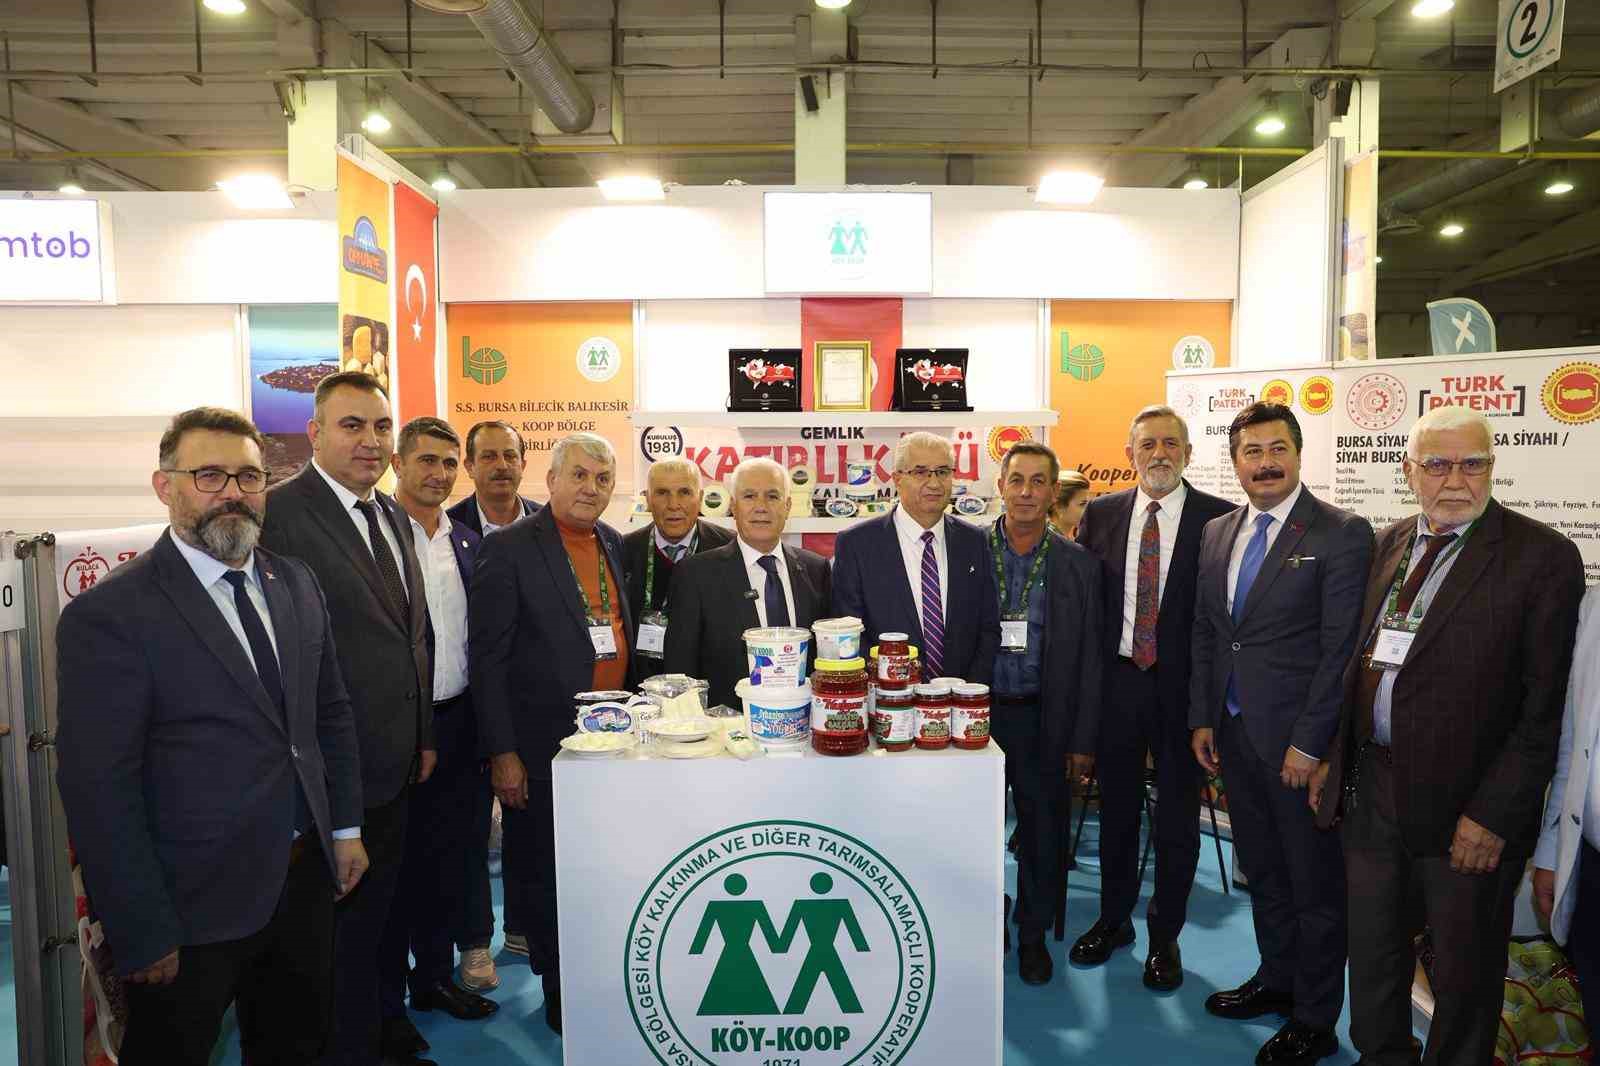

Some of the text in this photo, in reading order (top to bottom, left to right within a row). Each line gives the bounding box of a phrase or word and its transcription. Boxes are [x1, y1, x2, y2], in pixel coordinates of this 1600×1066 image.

[1520, 1, 1538, 46] 2
[455, 399, 629, 413] S.S. BURSA BİLECİK BALIKESİR
[1213, 398, 1251, 409] PATENT
[522, 419, 597, 432] KOOP BÖLGE
[647, 441, 676, 453] 1981
[1336, 436, 1374, 448] BURSA
[1336, 448, 1367, 463] SİYAH
[720, 836, 747, 854] VE
[752, 828, 811, 848] DİĞER
[646, 848, 721, 921] KALKINMA
[634, 924, 655, 962] KÖY
[631, 967, 672, 1044] BÖLGESİ
[711, 1020, 851, 1053] KÖY-KOOP
